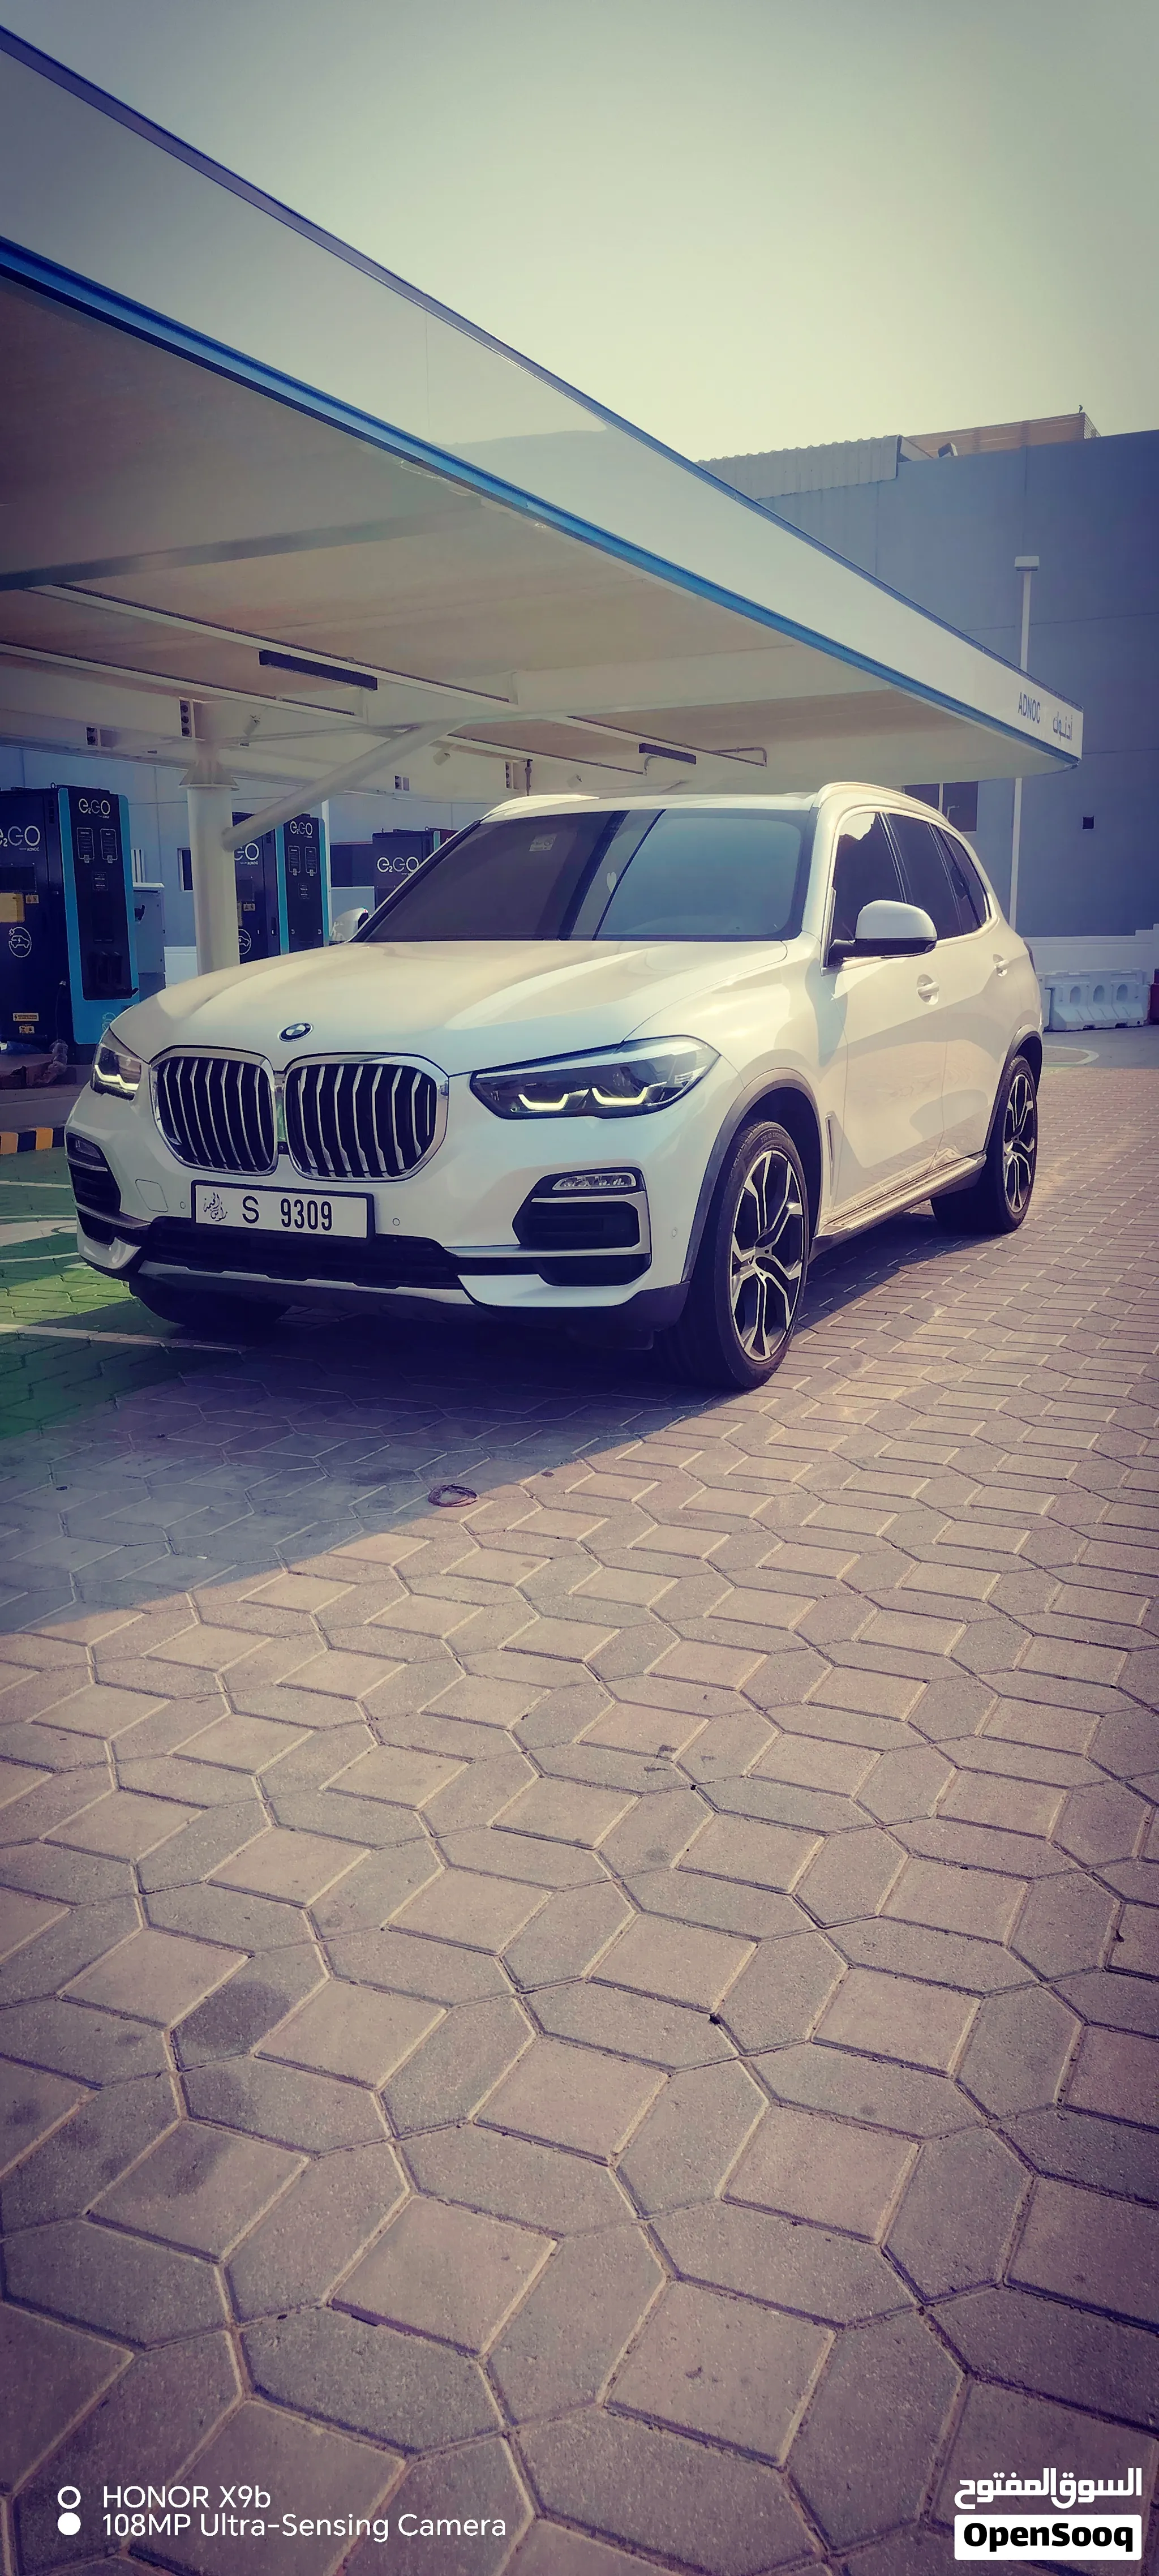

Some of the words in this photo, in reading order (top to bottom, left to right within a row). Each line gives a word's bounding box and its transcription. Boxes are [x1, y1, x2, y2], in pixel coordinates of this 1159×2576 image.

[1018, 692, 1040, 724] ADNOC
[242, 1195, 260, 1224] S
[280, 1198, 333, 1231] 9309
